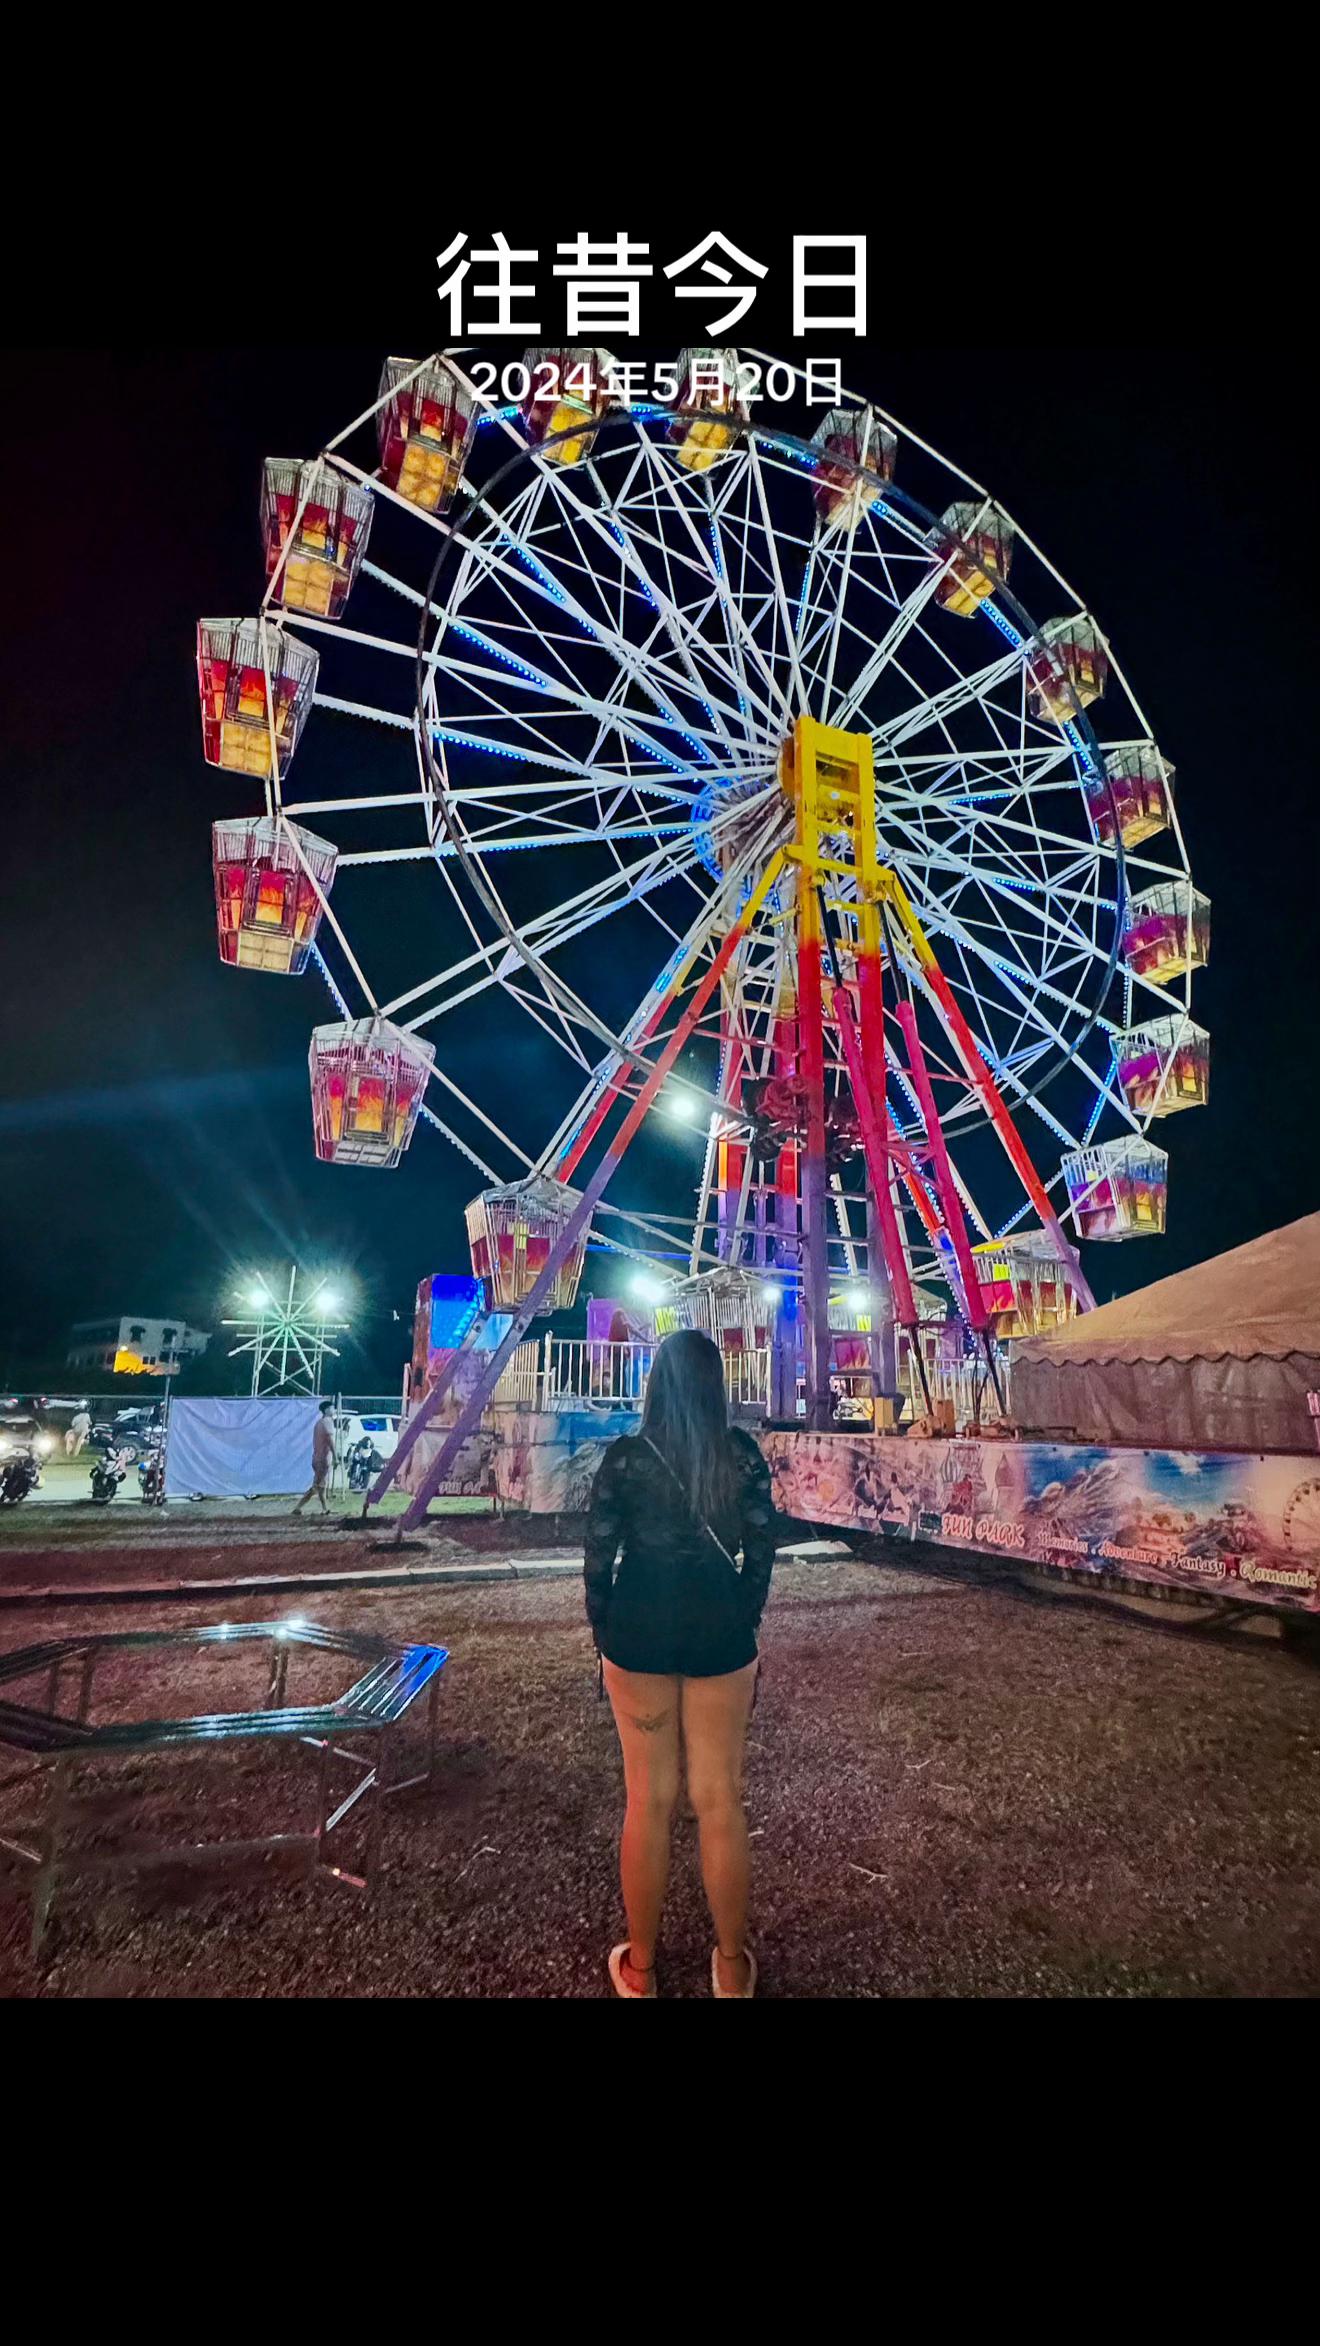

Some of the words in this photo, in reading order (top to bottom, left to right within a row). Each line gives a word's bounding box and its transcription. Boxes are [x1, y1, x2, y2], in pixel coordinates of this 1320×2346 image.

[942, 1512, 974, 1541] FUN
[975, 1518, 1026, 1549] PARK
[1169, 1550, 1226, 1578] Fantasy
